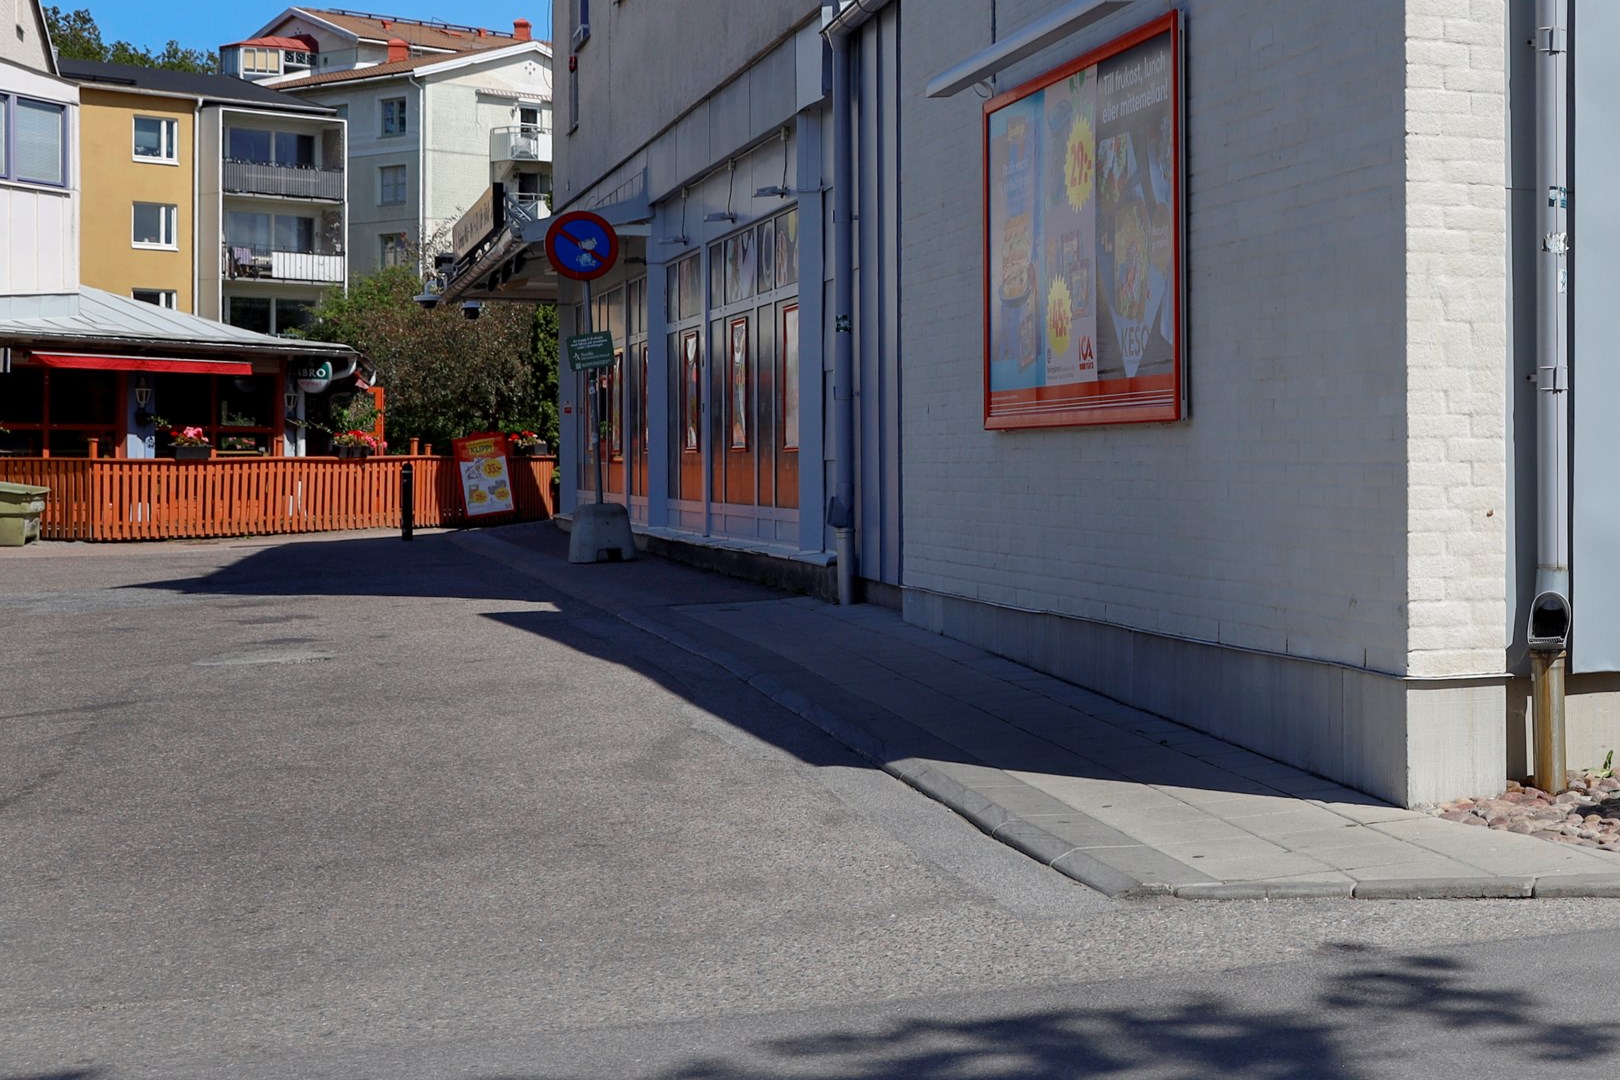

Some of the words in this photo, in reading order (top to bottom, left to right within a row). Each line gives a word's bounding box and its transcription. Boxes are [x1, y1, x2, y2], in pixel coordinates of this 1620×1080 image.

[1103, 71, 1114, 96] Till
[1115, 63, 1143, 91] frukost,
[1144, 50, 1166, 78] lunch
[1102, 100, 1120, 124] eller
[1120, 77, 1169, 118] mittemellan!
[1079, 335, 1093, 361] ICA
